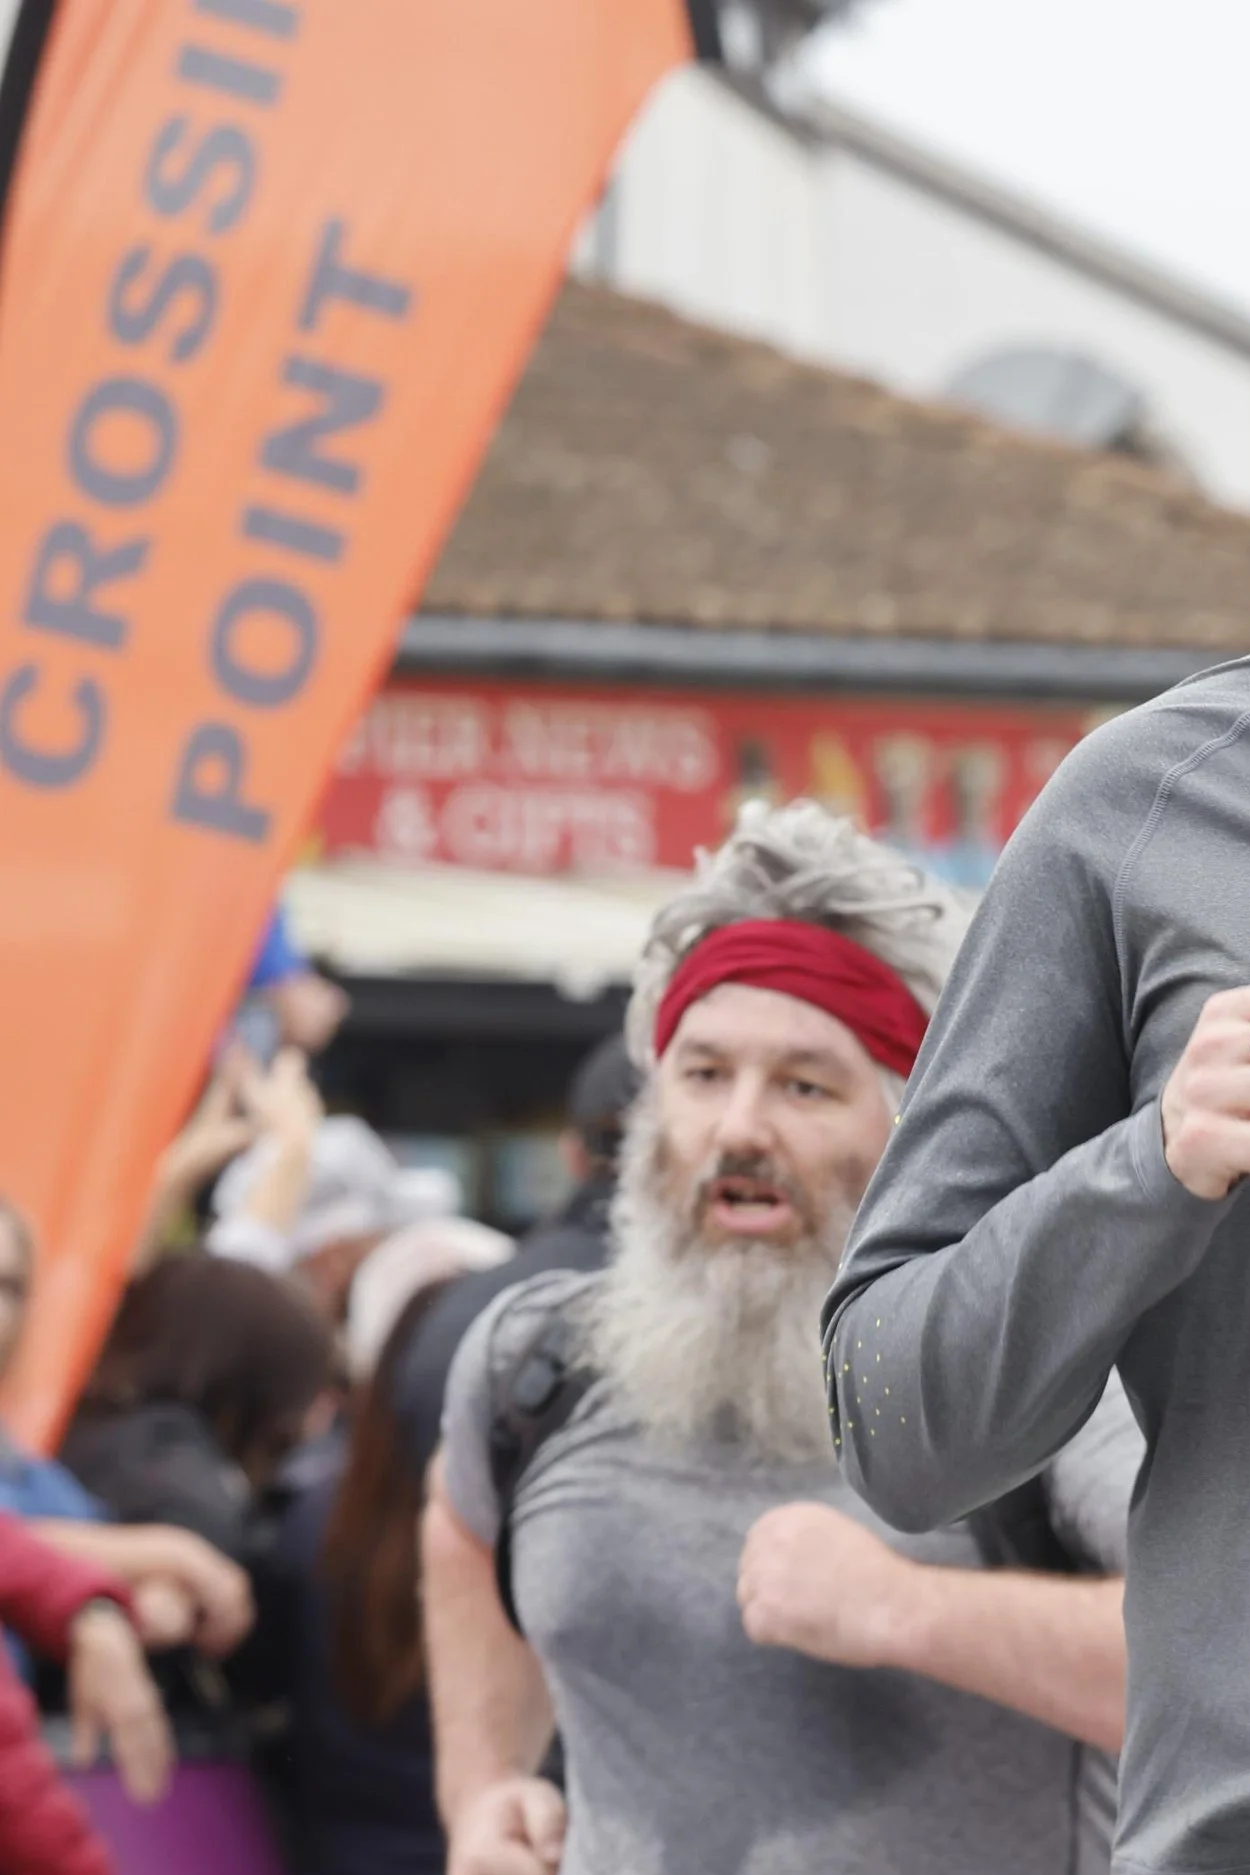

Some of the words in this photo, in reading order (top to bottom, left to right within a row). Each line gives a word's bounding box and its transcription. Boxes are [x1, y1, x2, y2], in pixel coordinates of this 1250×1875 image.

[0, 0, 304, 794] CROSSI
[165, 210, 420, 848] POINT
[438, 776, 658, 872] GIFTS
[506, 696, 720, 792] NEWS
